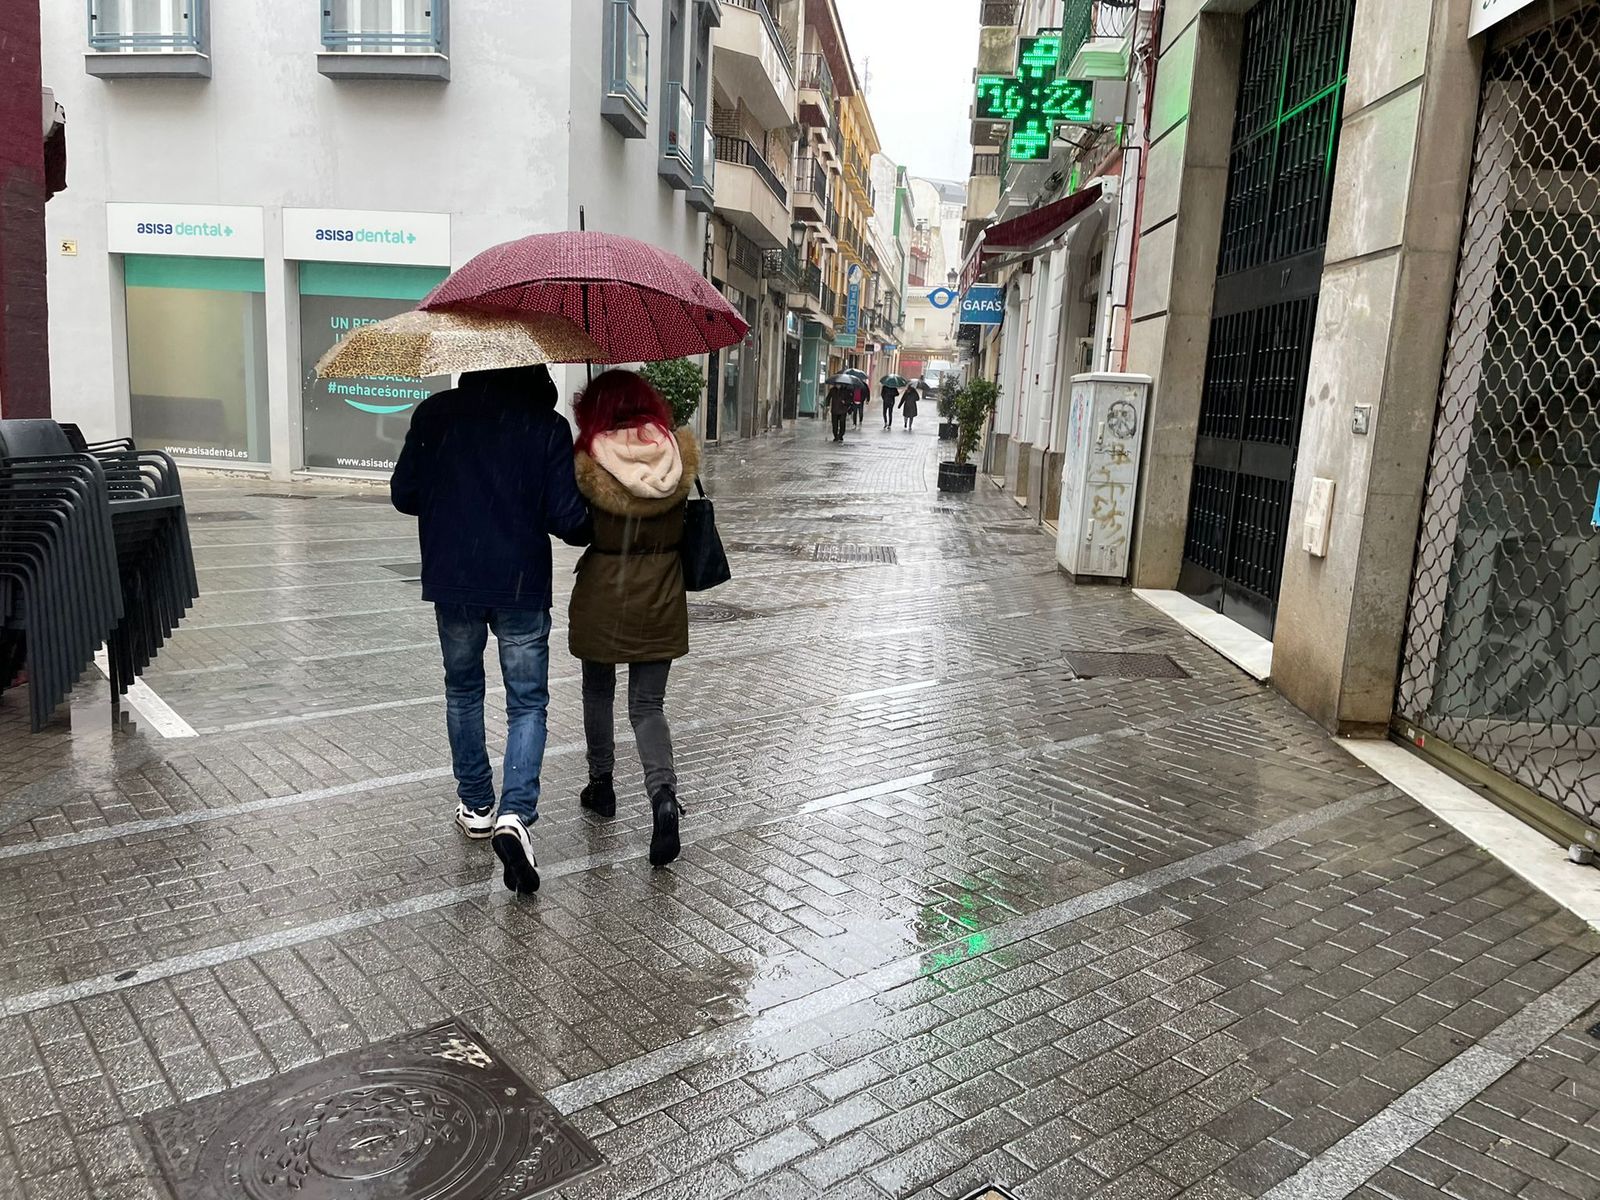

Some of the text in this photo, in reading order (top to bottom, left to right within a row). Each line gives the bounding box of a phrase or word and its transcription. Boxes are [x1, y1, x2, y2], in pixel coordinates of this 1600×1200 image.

[988, 85, 1082, 115] 16:22
[137, 222, 222, 237] asisa dental
[315, 228, 405, 244] asisa dental
[962, 300, 1002, 312] GAFAS
[330, 316, 349, 329] UN
[164, 446, 248, 458] www.asisadental.es
